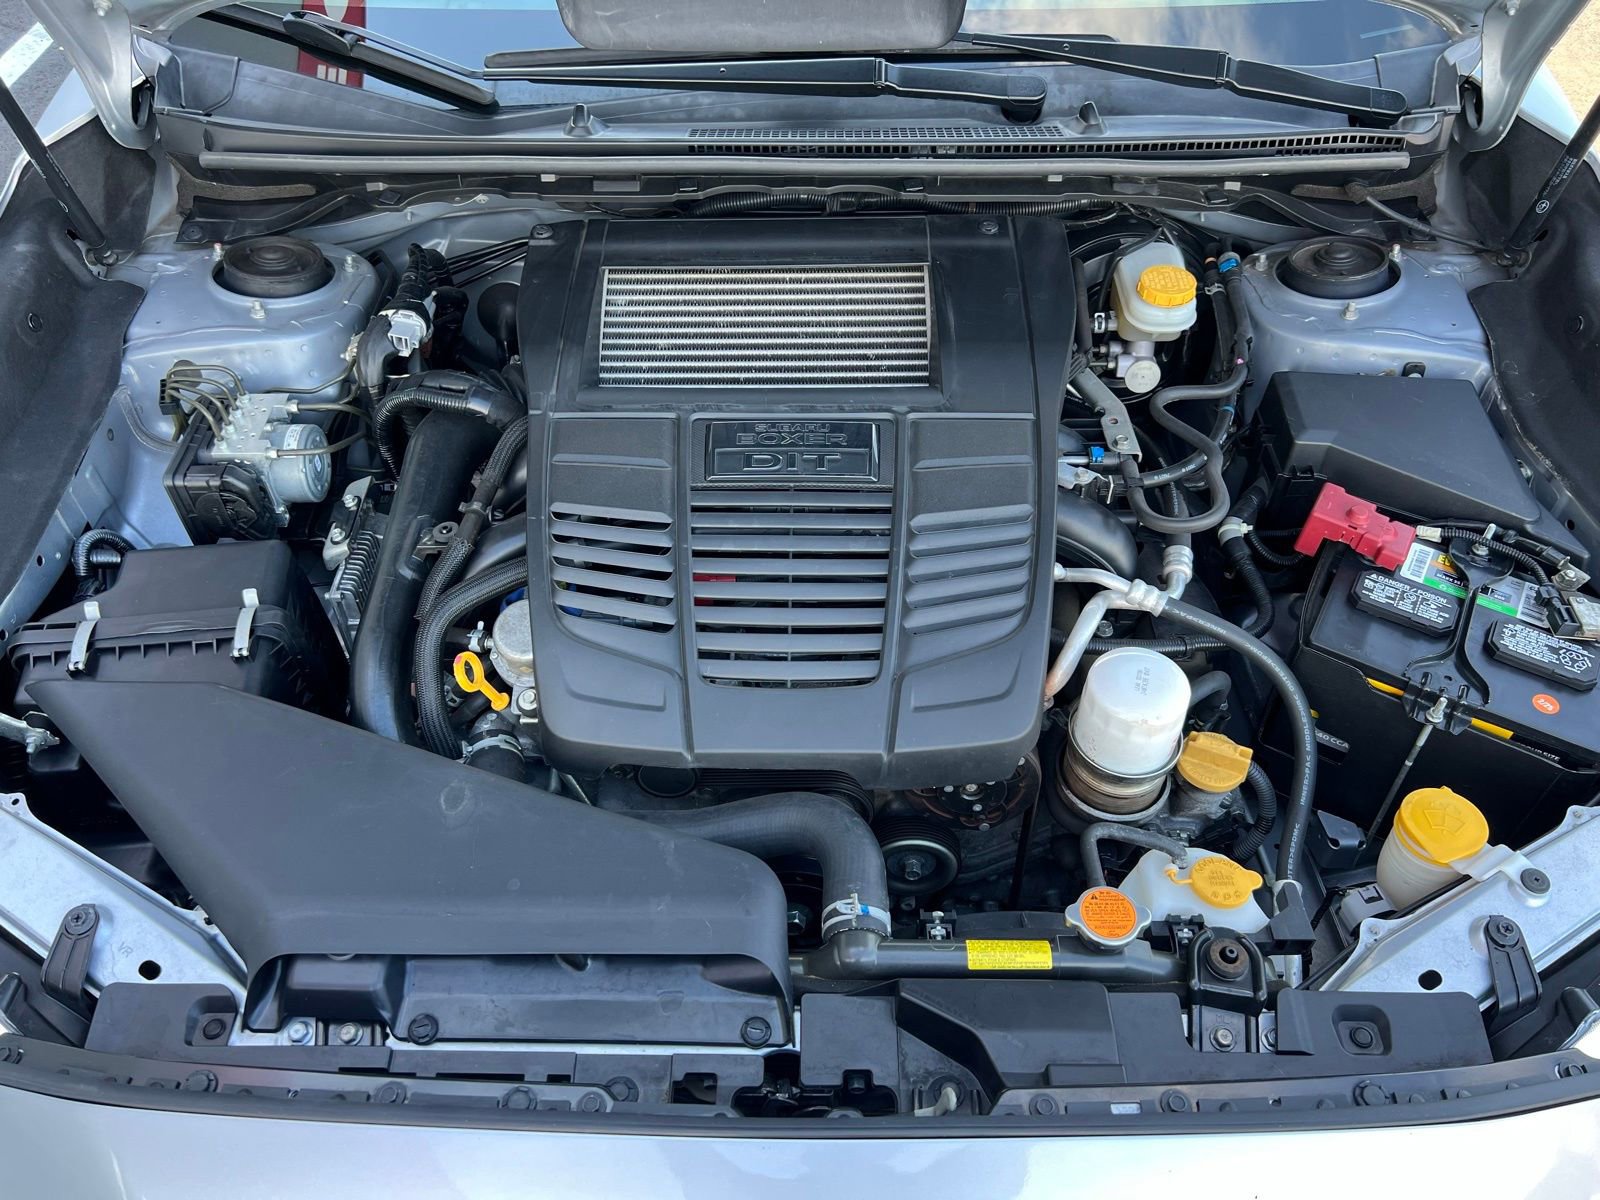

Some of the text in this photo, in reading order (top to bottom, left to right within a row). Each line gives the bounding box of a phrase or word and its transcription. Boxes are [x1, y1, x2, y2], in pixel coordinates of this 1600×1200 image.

[755, 423, 831, 433] SUBARU
[736, 433, 848, 446] BOXER
[742, 453, 842, 471] DIT
[1378, 575, 1411, 591] DANGER
[1417, 589, 1447, 604] POISON
[1330, 736, 1349, 749] CCA
